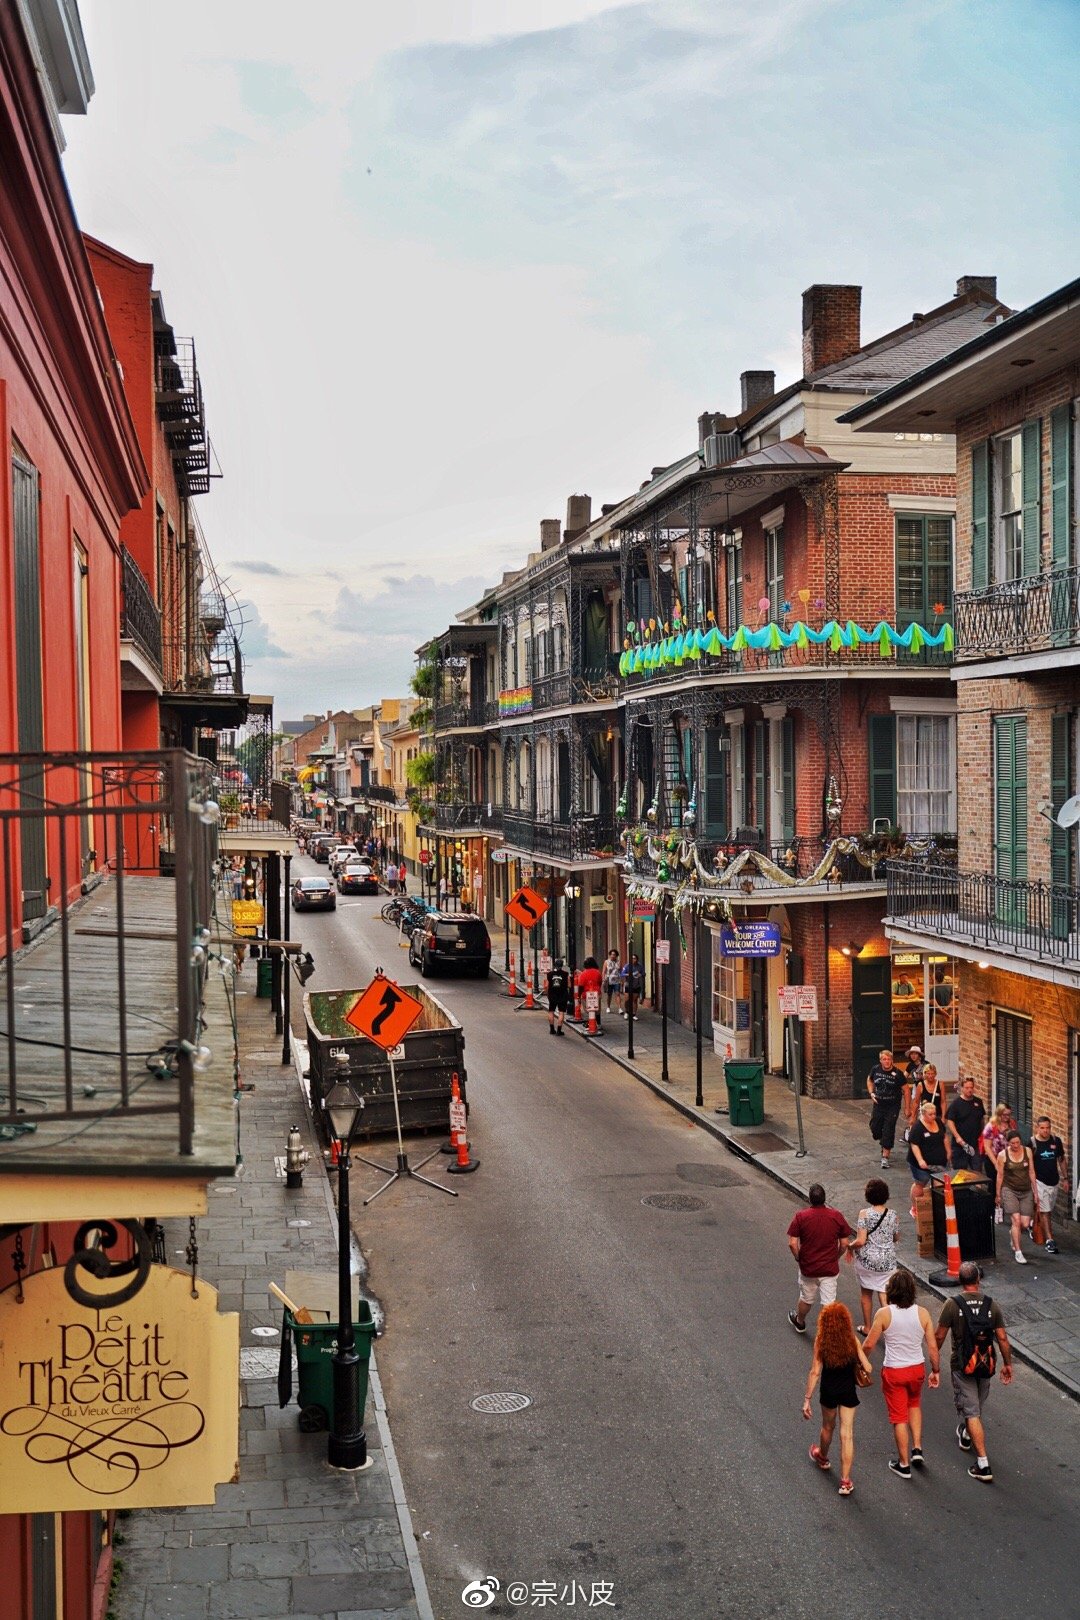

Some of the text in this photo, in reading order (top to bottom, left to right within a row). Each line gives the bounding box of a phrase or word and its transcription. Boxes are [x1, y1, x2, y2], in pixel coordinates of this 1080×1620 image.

[242, 912, 261, 920] SHOP
[755, 939, 777, 948] CENTER
[95, 1309, 123, 1333] Le
[58, 1323, 171, 1369] Petit
[19, 1357, 189, 1406] Théâtre
[62, 1403, 141, 1417] du Vieux Carré
